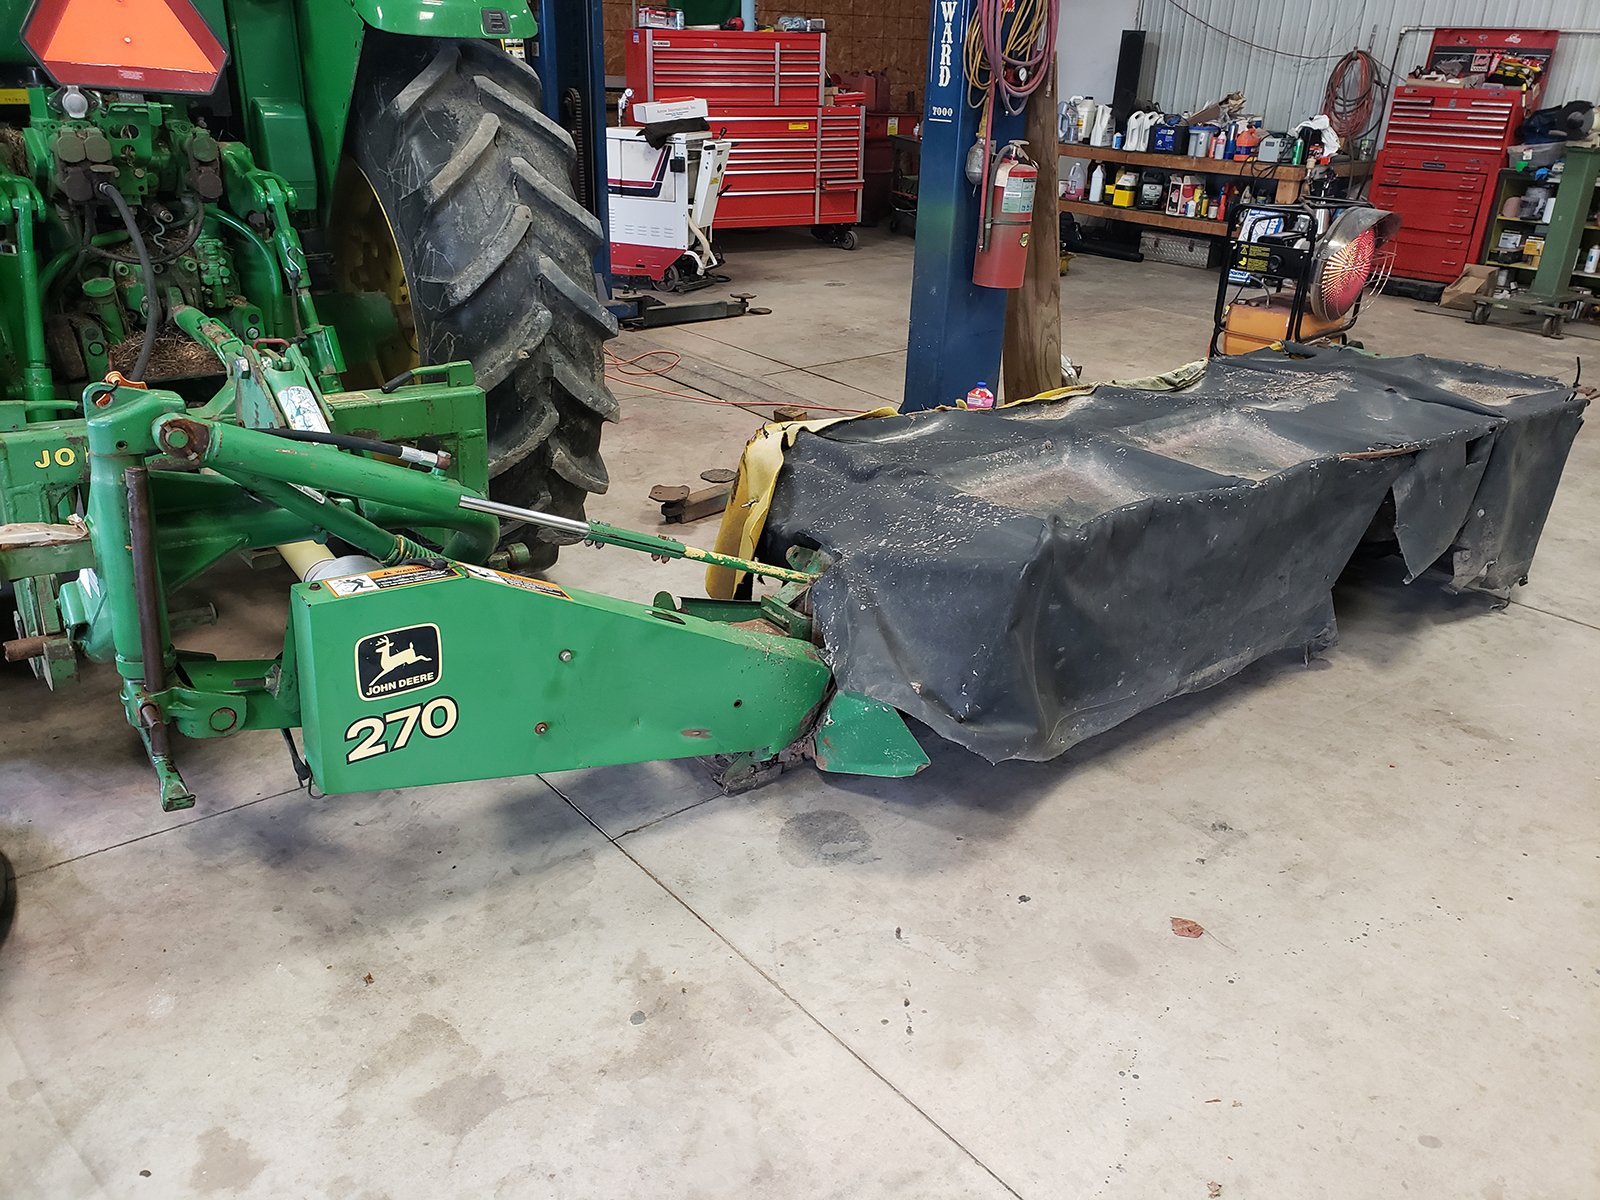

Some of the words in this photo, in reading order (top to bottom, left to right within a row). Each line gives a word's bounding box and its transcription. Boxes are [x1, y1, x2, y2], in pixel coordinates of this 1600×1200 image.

[938, 1, 958, 87] WARD
[932, 106, 953, 117] 7000
[34, 446, 89, 468] JO
[366, 681, 397, 696] JOHN
[398, 672, 434, 688] DEERE
[344, 695, 459, 765] 270
